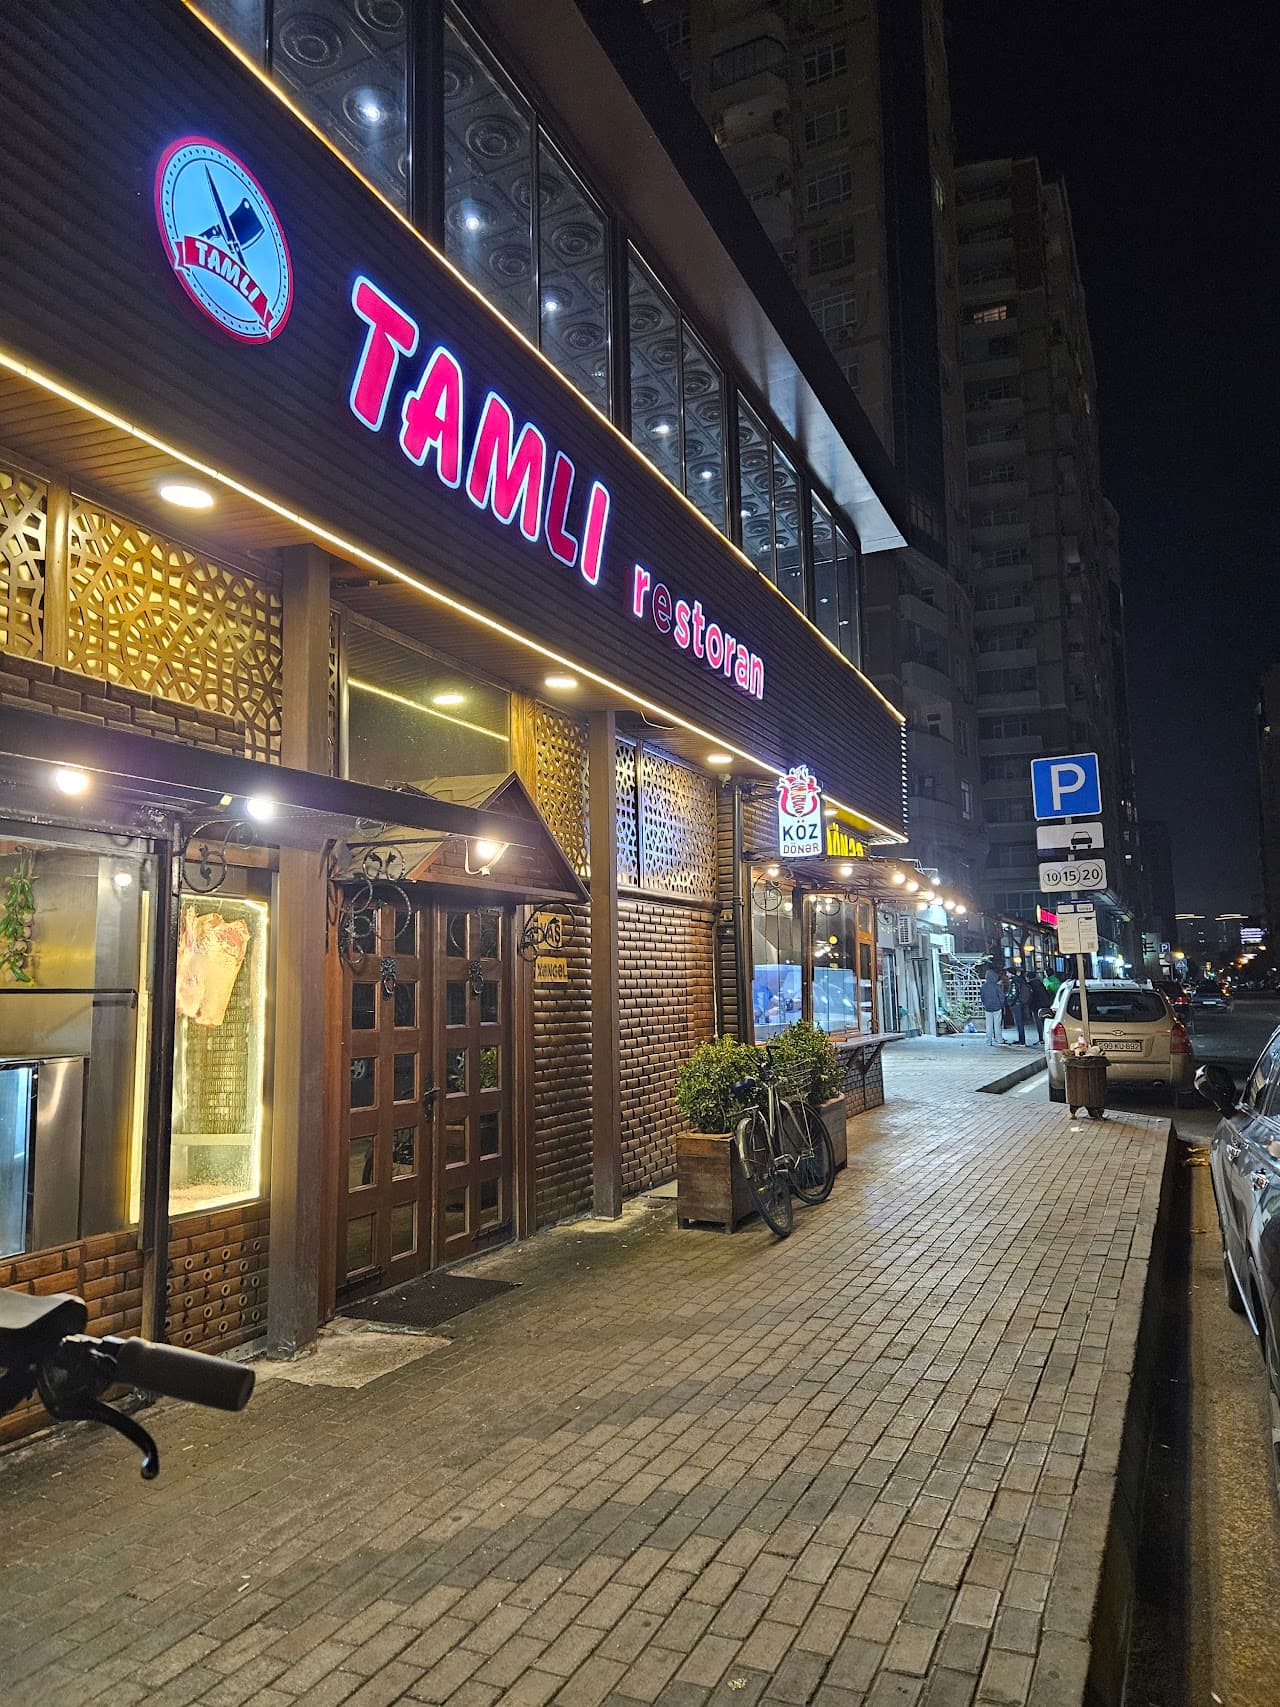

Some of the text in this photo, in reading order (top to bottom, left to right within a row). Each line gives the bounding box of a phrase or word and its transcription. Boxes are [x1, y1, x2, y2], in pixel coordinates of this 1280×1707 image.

[196, 240, 260, 304] TAMLI
[349, 275, 765, 700] TAMLI restoran
[1050, 763, 1086, 811] P
[783, 820, 818, 841] KÖZ
[1046, 869, 1100, 882] 10 15 20
